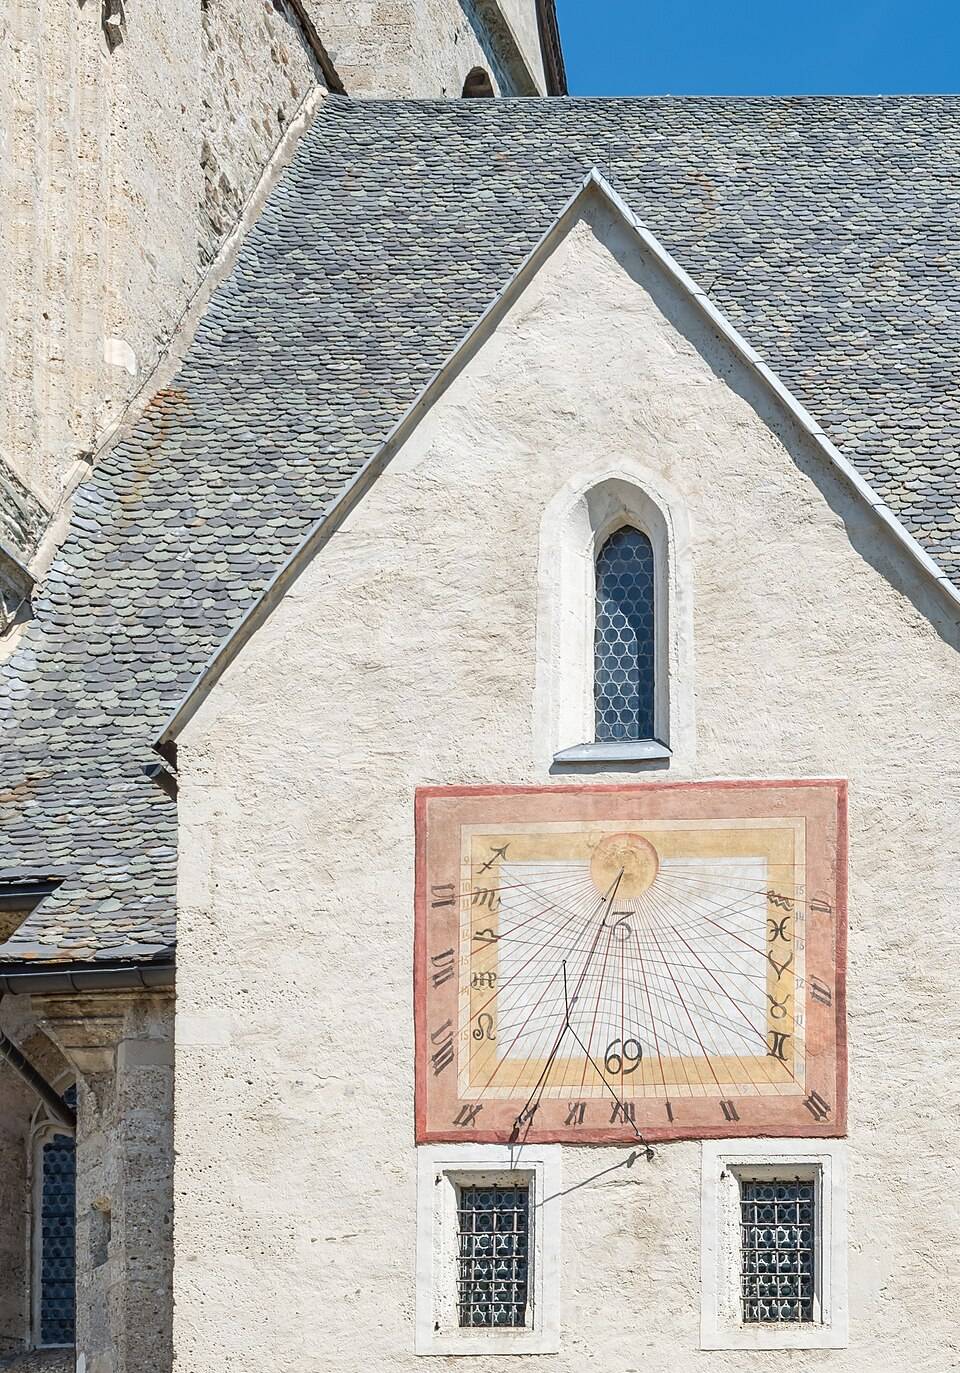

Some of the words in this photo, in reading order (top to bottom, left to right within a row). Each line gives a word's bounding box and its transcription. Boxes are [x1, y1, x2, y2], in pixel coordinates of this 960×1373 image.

[452, 1103, 484, 1128] IX
[563, 1101, 587, 1126] XI
[608, 1101, 637, 1125] XII
[719, 1100, 741, 1122] II
[802, 1087, 832, 1122] III
